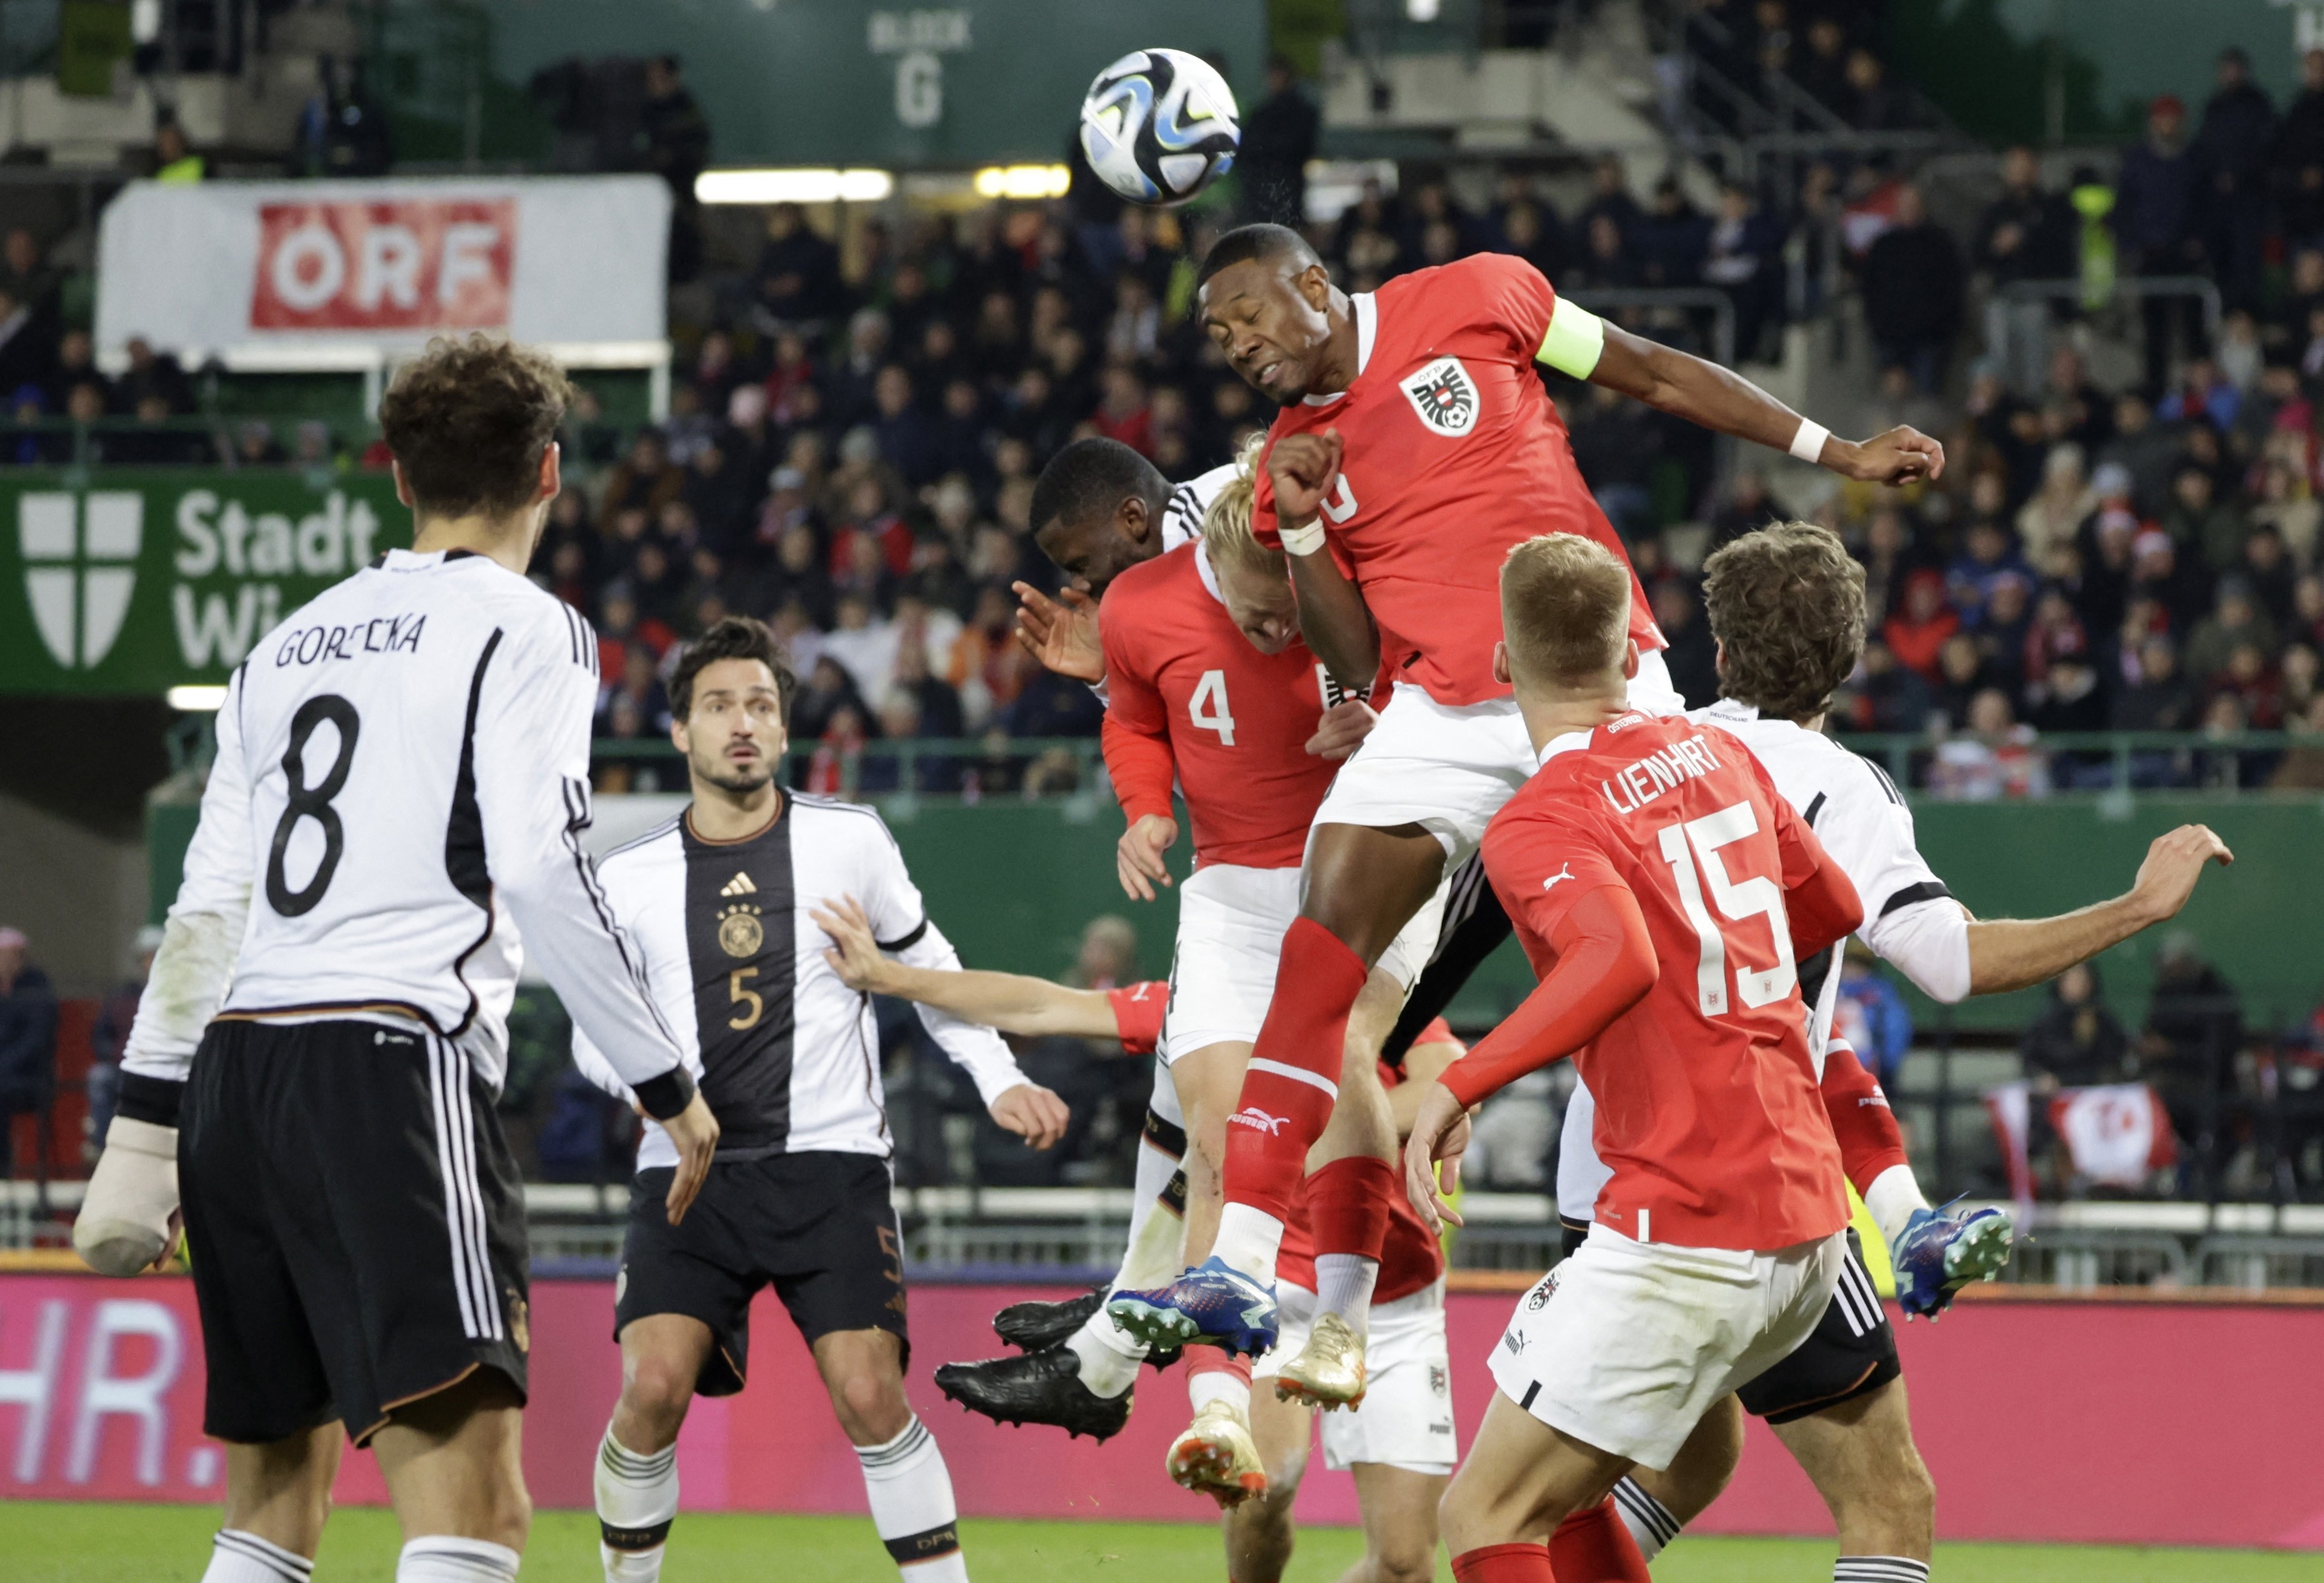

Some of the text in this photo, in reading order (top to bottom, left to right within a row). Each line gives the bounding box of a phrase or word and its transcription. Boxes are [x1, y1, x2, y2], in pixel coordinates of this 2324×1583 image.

[896, 52, 943, 127] G
[272, 224, 496, 314] ORF
[176, 489, 379, 577] Stadt
[1188, 669, 1235, 746] 4
[266, 694, 360, 917] 8
[1658, 799, 1797, 1017] 15
[729, 967, 763, 1030] 5
